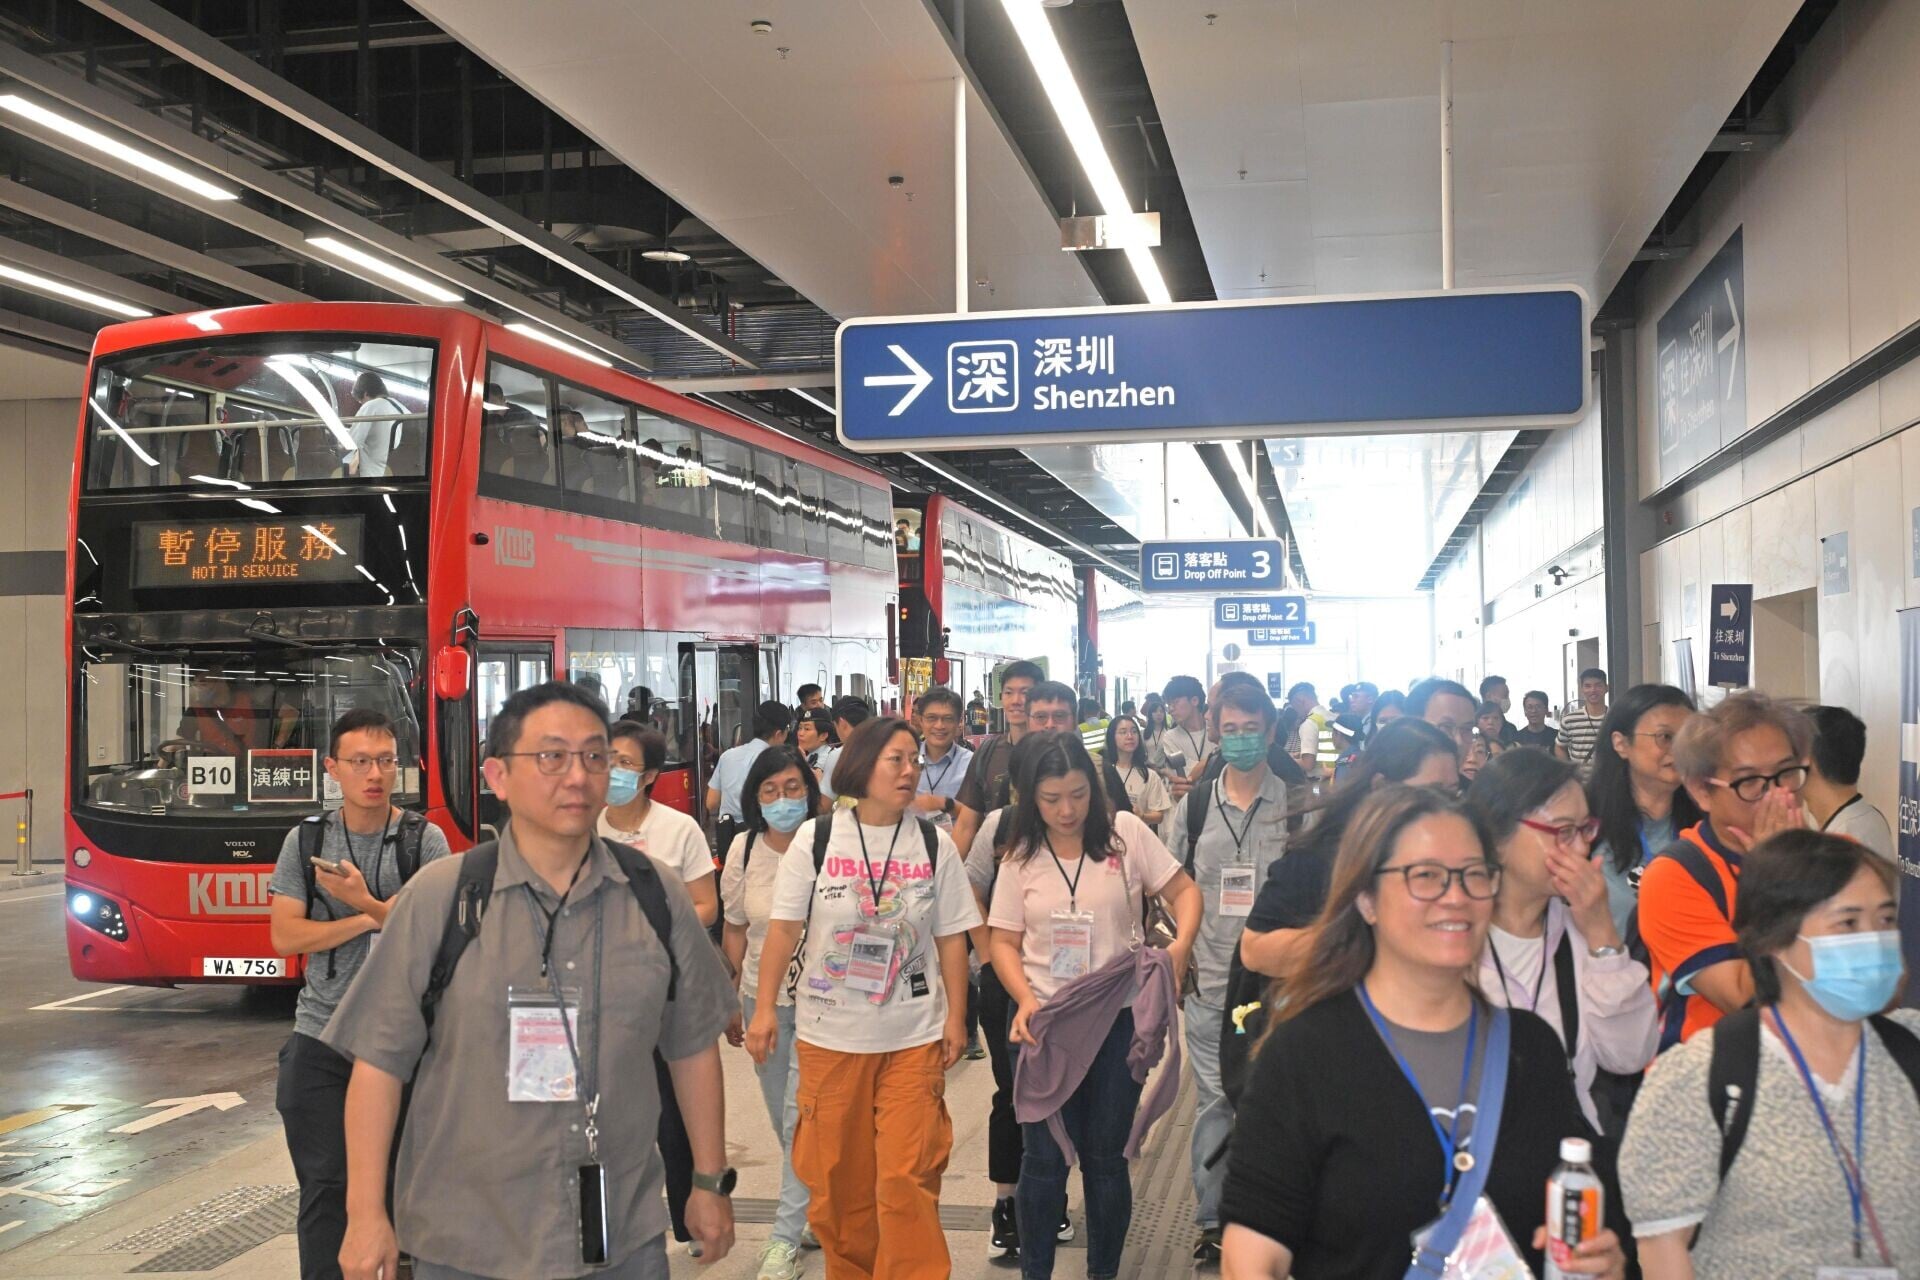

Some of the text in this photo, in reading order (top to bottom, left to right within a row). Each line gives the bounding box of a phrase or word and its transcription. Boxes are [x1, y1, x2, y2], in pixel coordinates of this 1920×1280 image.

[1033, 334, 1115, 378] 深圳
[956, 351, 1009, 404] 深
[1033, 381, 1175, 410] Shenzhen
[158, 522, 336, 566] 暫停服務
[1184, 551, 1228, 568] 落客點
[1251, 550, 1271, 579] 3
[192, 563, 299, 580] NOT IN SERVICE
[1184, 568, 1247, 581] Drop Off Point
[1242, 614, 1256, 623] Drop
[1285, 602, 1298, 620] 2
[1303, 626, 1310, 640] 1
[1714, 629, 1745, 646] 往深圳
[1713, 652, 1745, 662] To Shenzhen
[191, 766, 231, 785] B10
[252, 767, 311, 788] 演練中
[1899, 796, 1920, 838] 往深
[213, 959, 277, 975] WA 756
